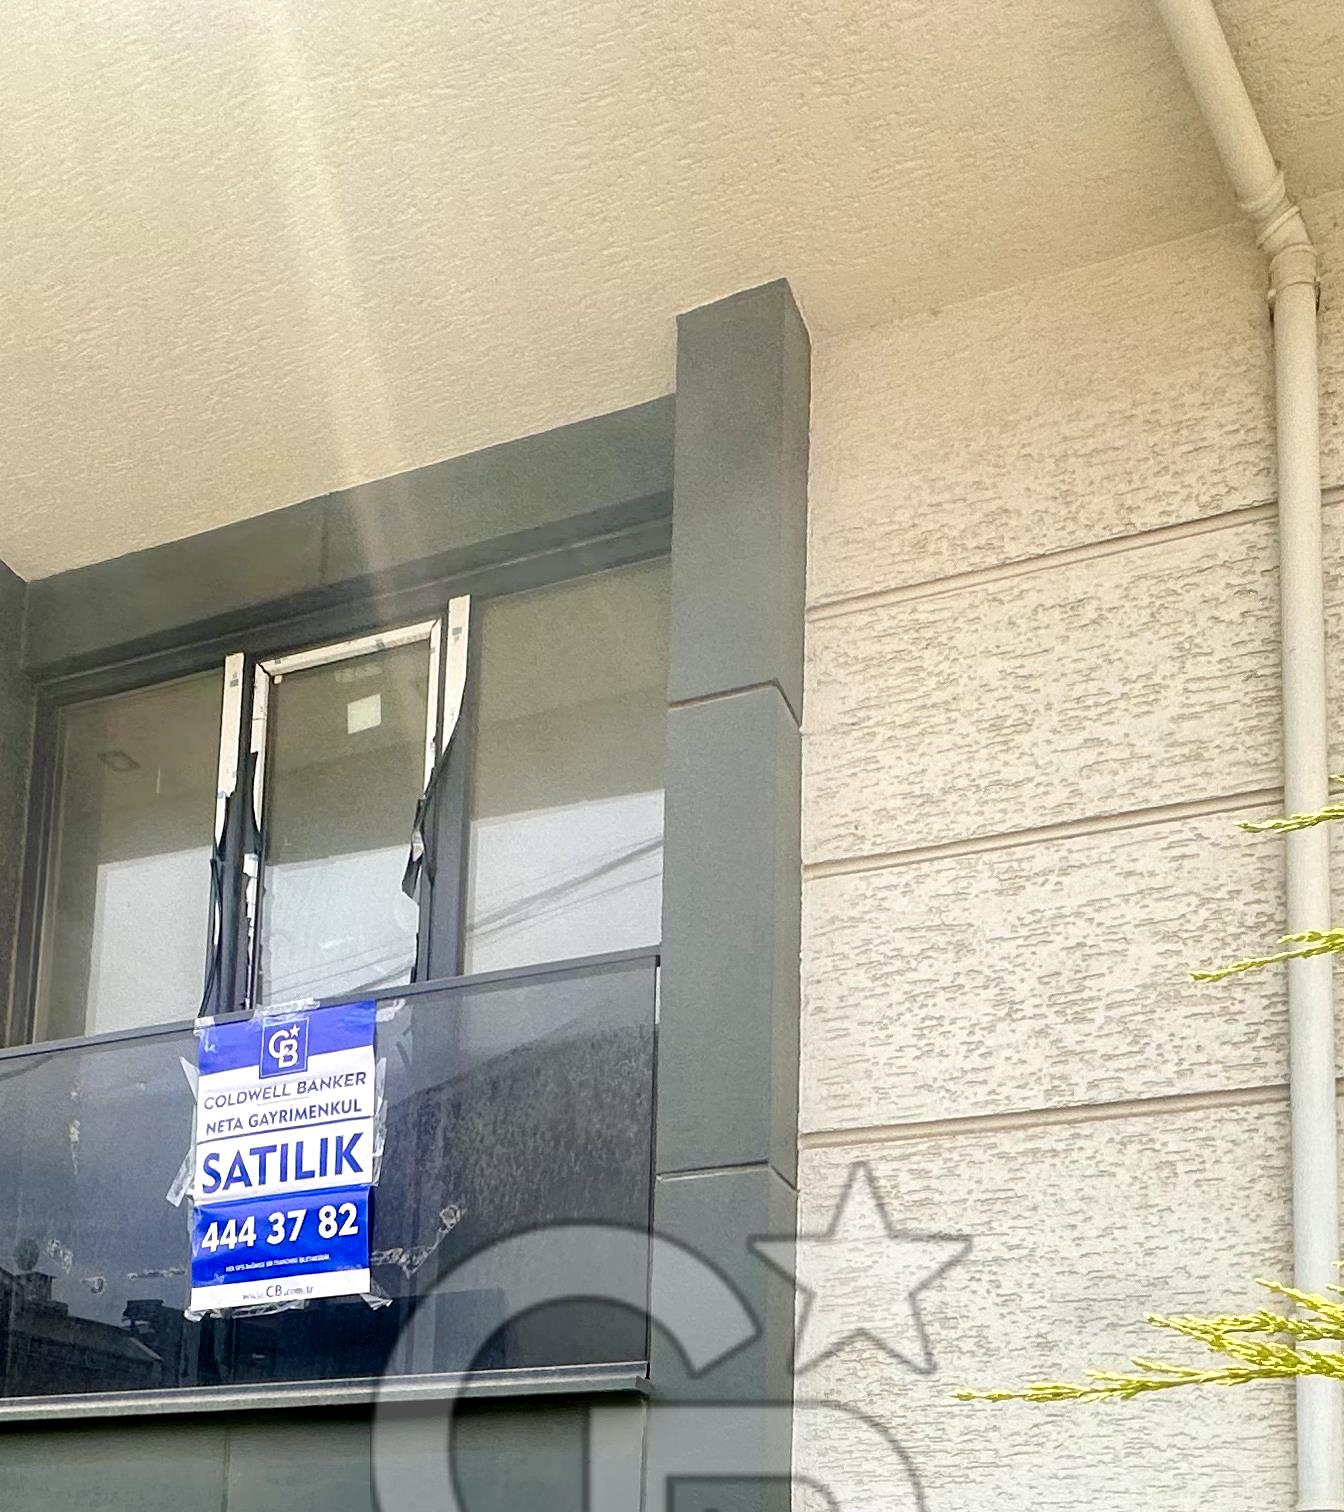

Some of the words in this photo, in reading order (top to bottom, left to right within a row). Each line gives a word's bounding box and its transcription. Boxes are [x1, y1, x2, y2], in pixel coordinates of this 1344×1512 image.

[204, 1083, 291, 1110] COLDWELL
[297, 1071, 367, 1095] BANKER
[206, 1117, 244, 1135] NETA
[202, 1132, 364, 1194] SATILIK
[201, 1216, 257, 1252] 444
[266, 1208, 307, 1245] 37
[318, 1202, 359, 1239] 82
